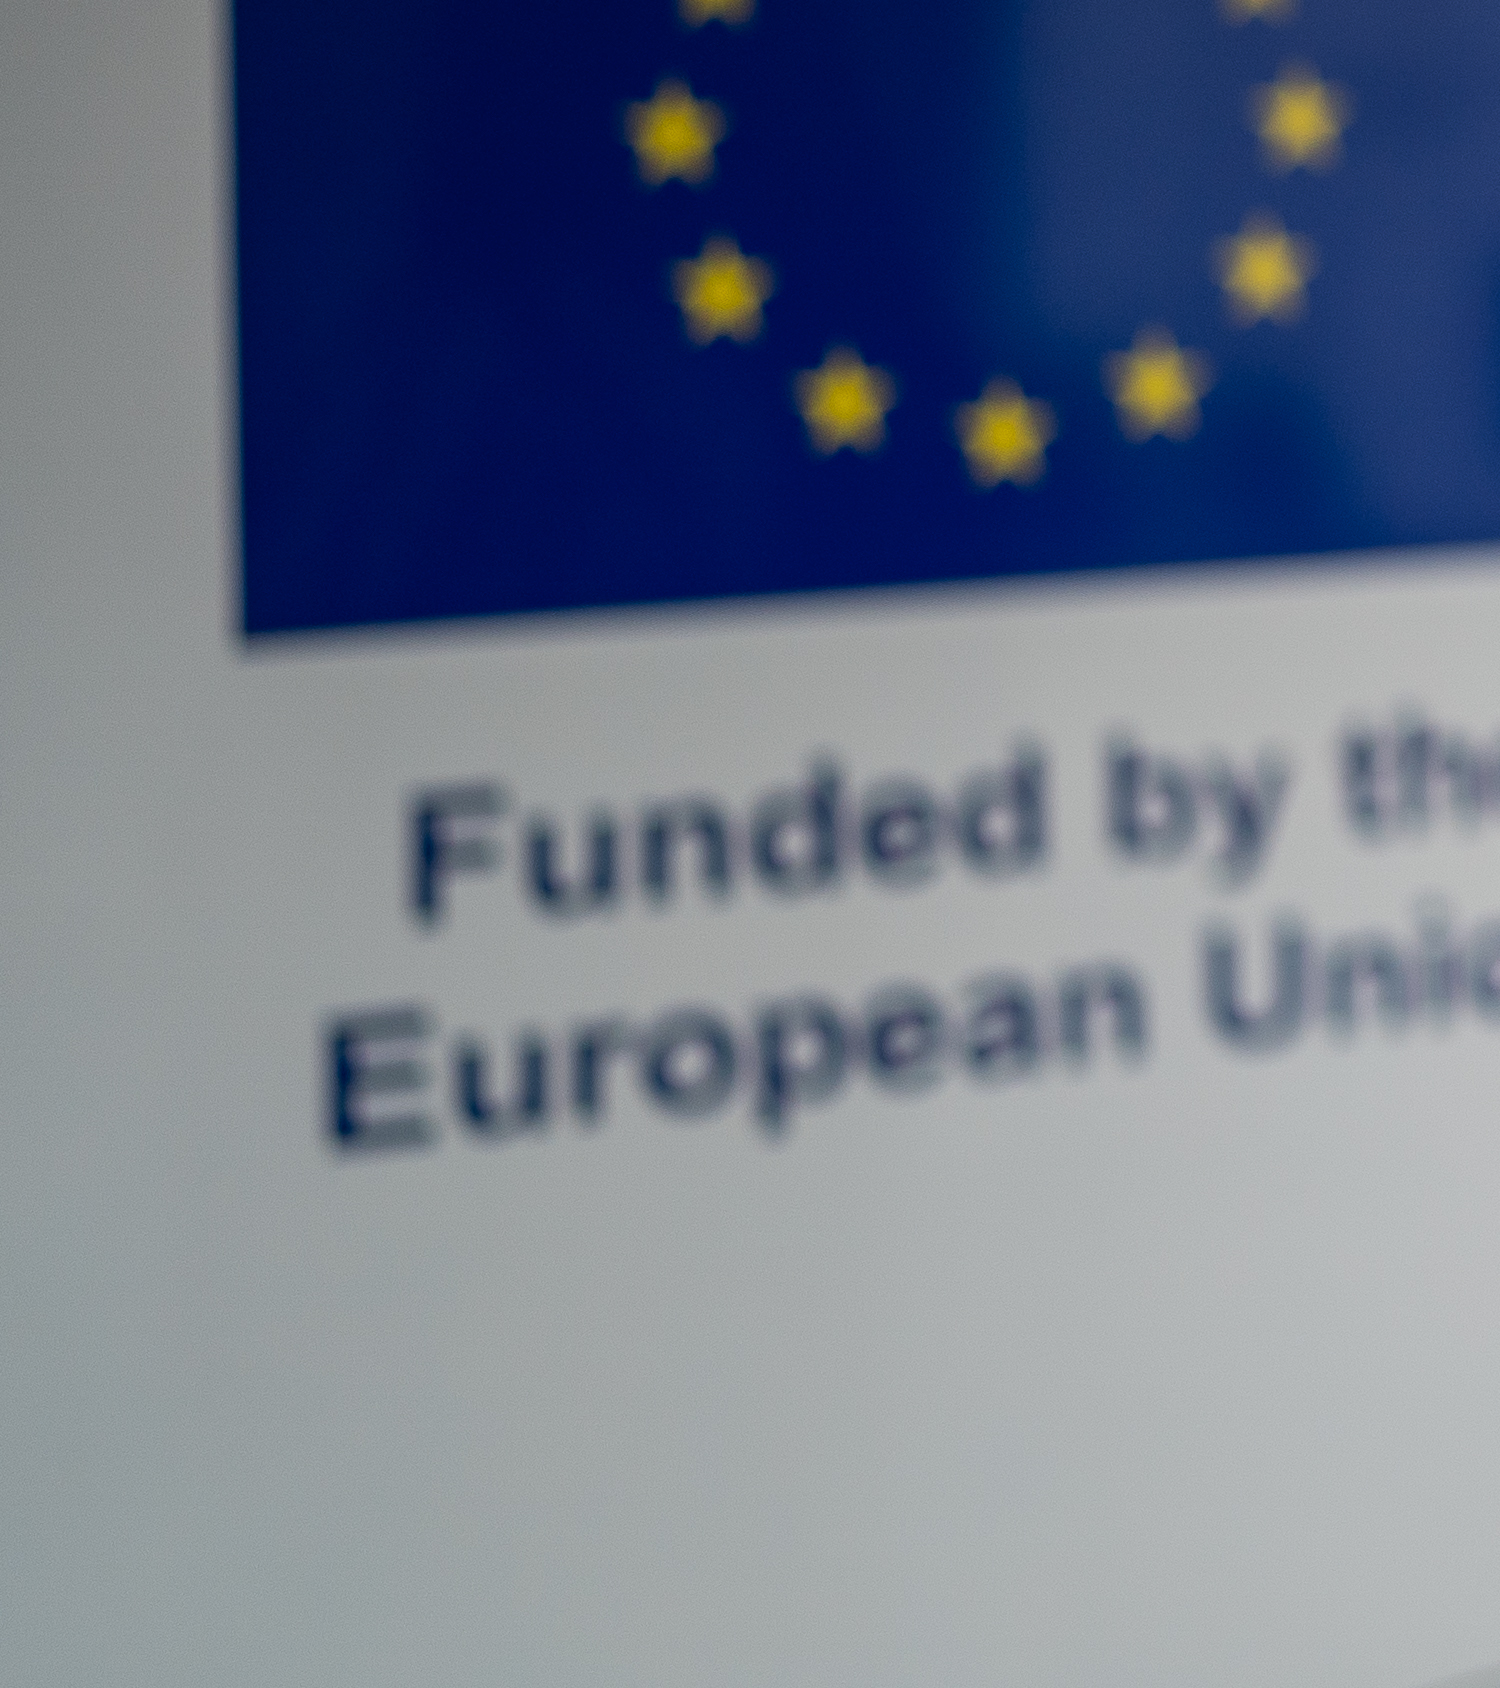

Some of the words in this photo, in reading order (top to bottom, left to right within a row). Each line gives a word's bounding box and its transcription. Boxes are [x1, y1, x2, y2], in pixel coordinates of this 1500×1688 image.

[408, 736, 1050, 934] Funded
[1098, 726, 1290, 890] by
[324, 957, 1150, 1158] European
